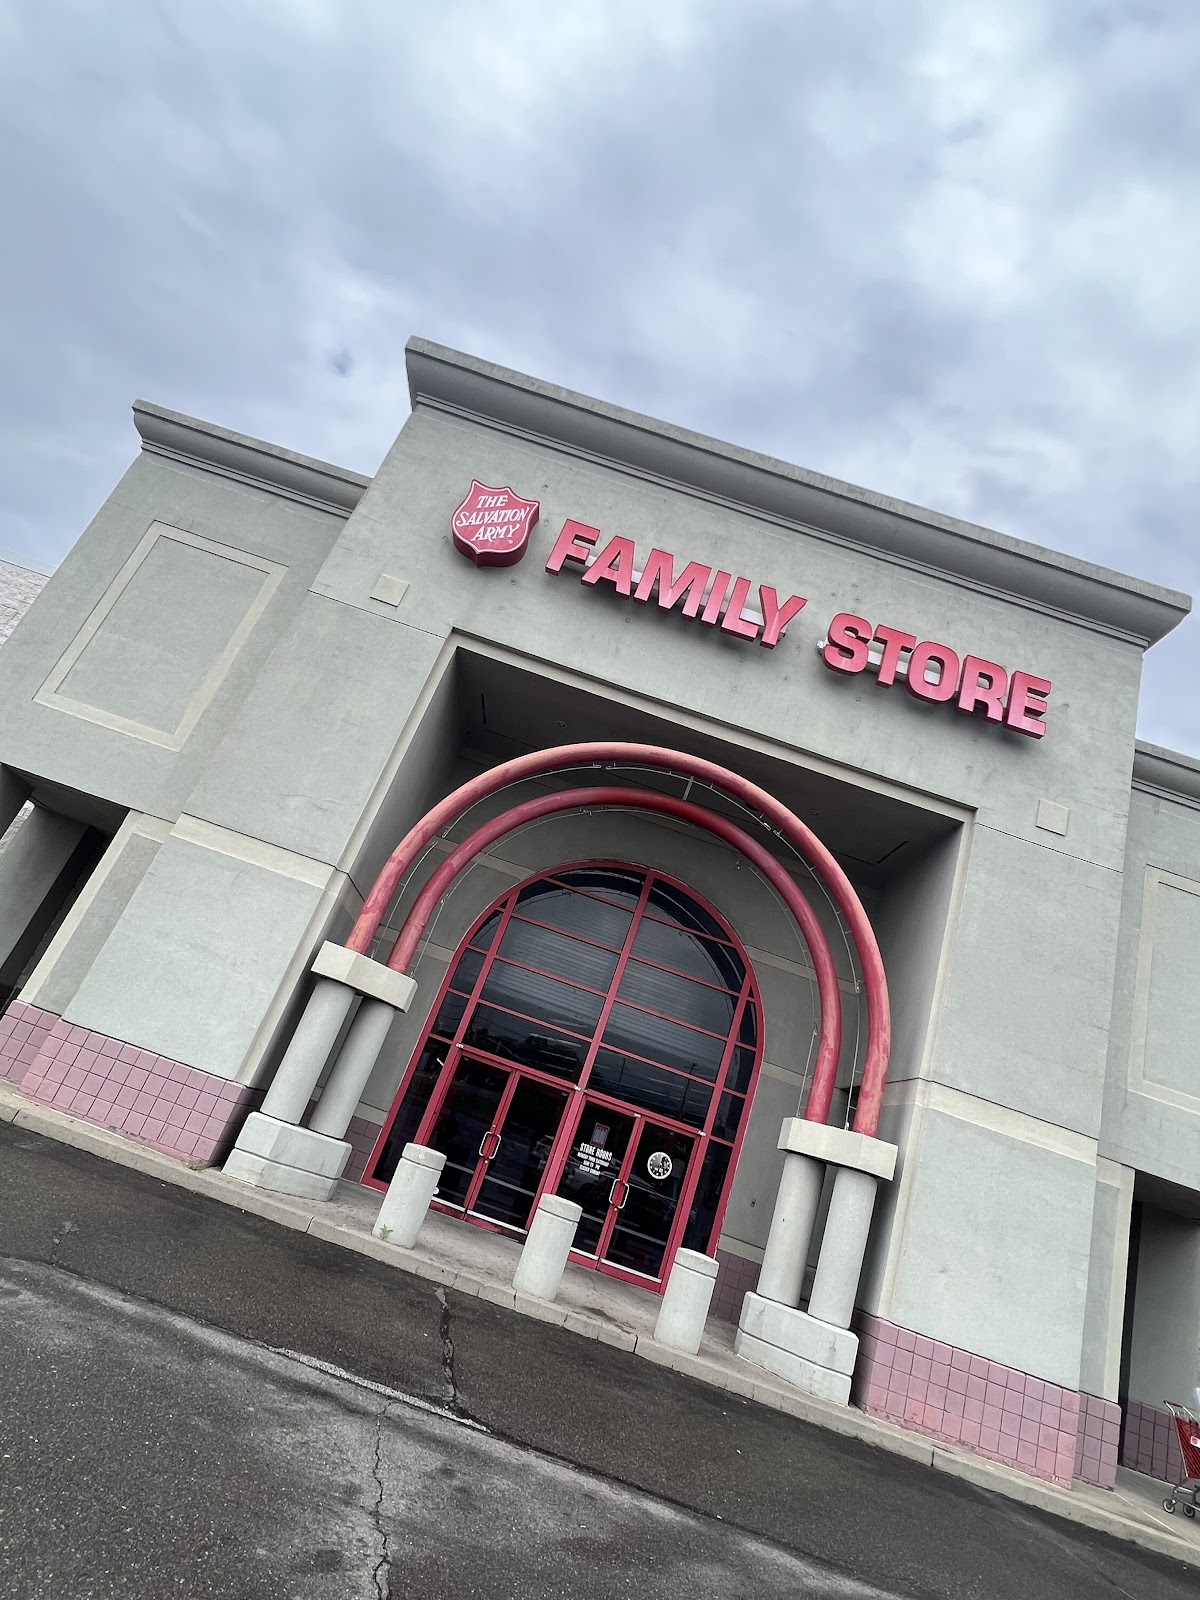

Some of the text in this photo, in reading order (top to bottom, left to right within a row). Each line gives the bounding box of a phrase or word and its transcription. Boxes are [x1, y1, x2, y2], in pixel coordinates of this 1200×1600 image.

[477, 495, 508, 508] THE
[456, 506, 530, 526] SALVATION
[470, 523, 520, 542] ARMY
[545, 518, 1052, 739] FAMILY STORE
[580, 1142, 596, 1155] STORE
